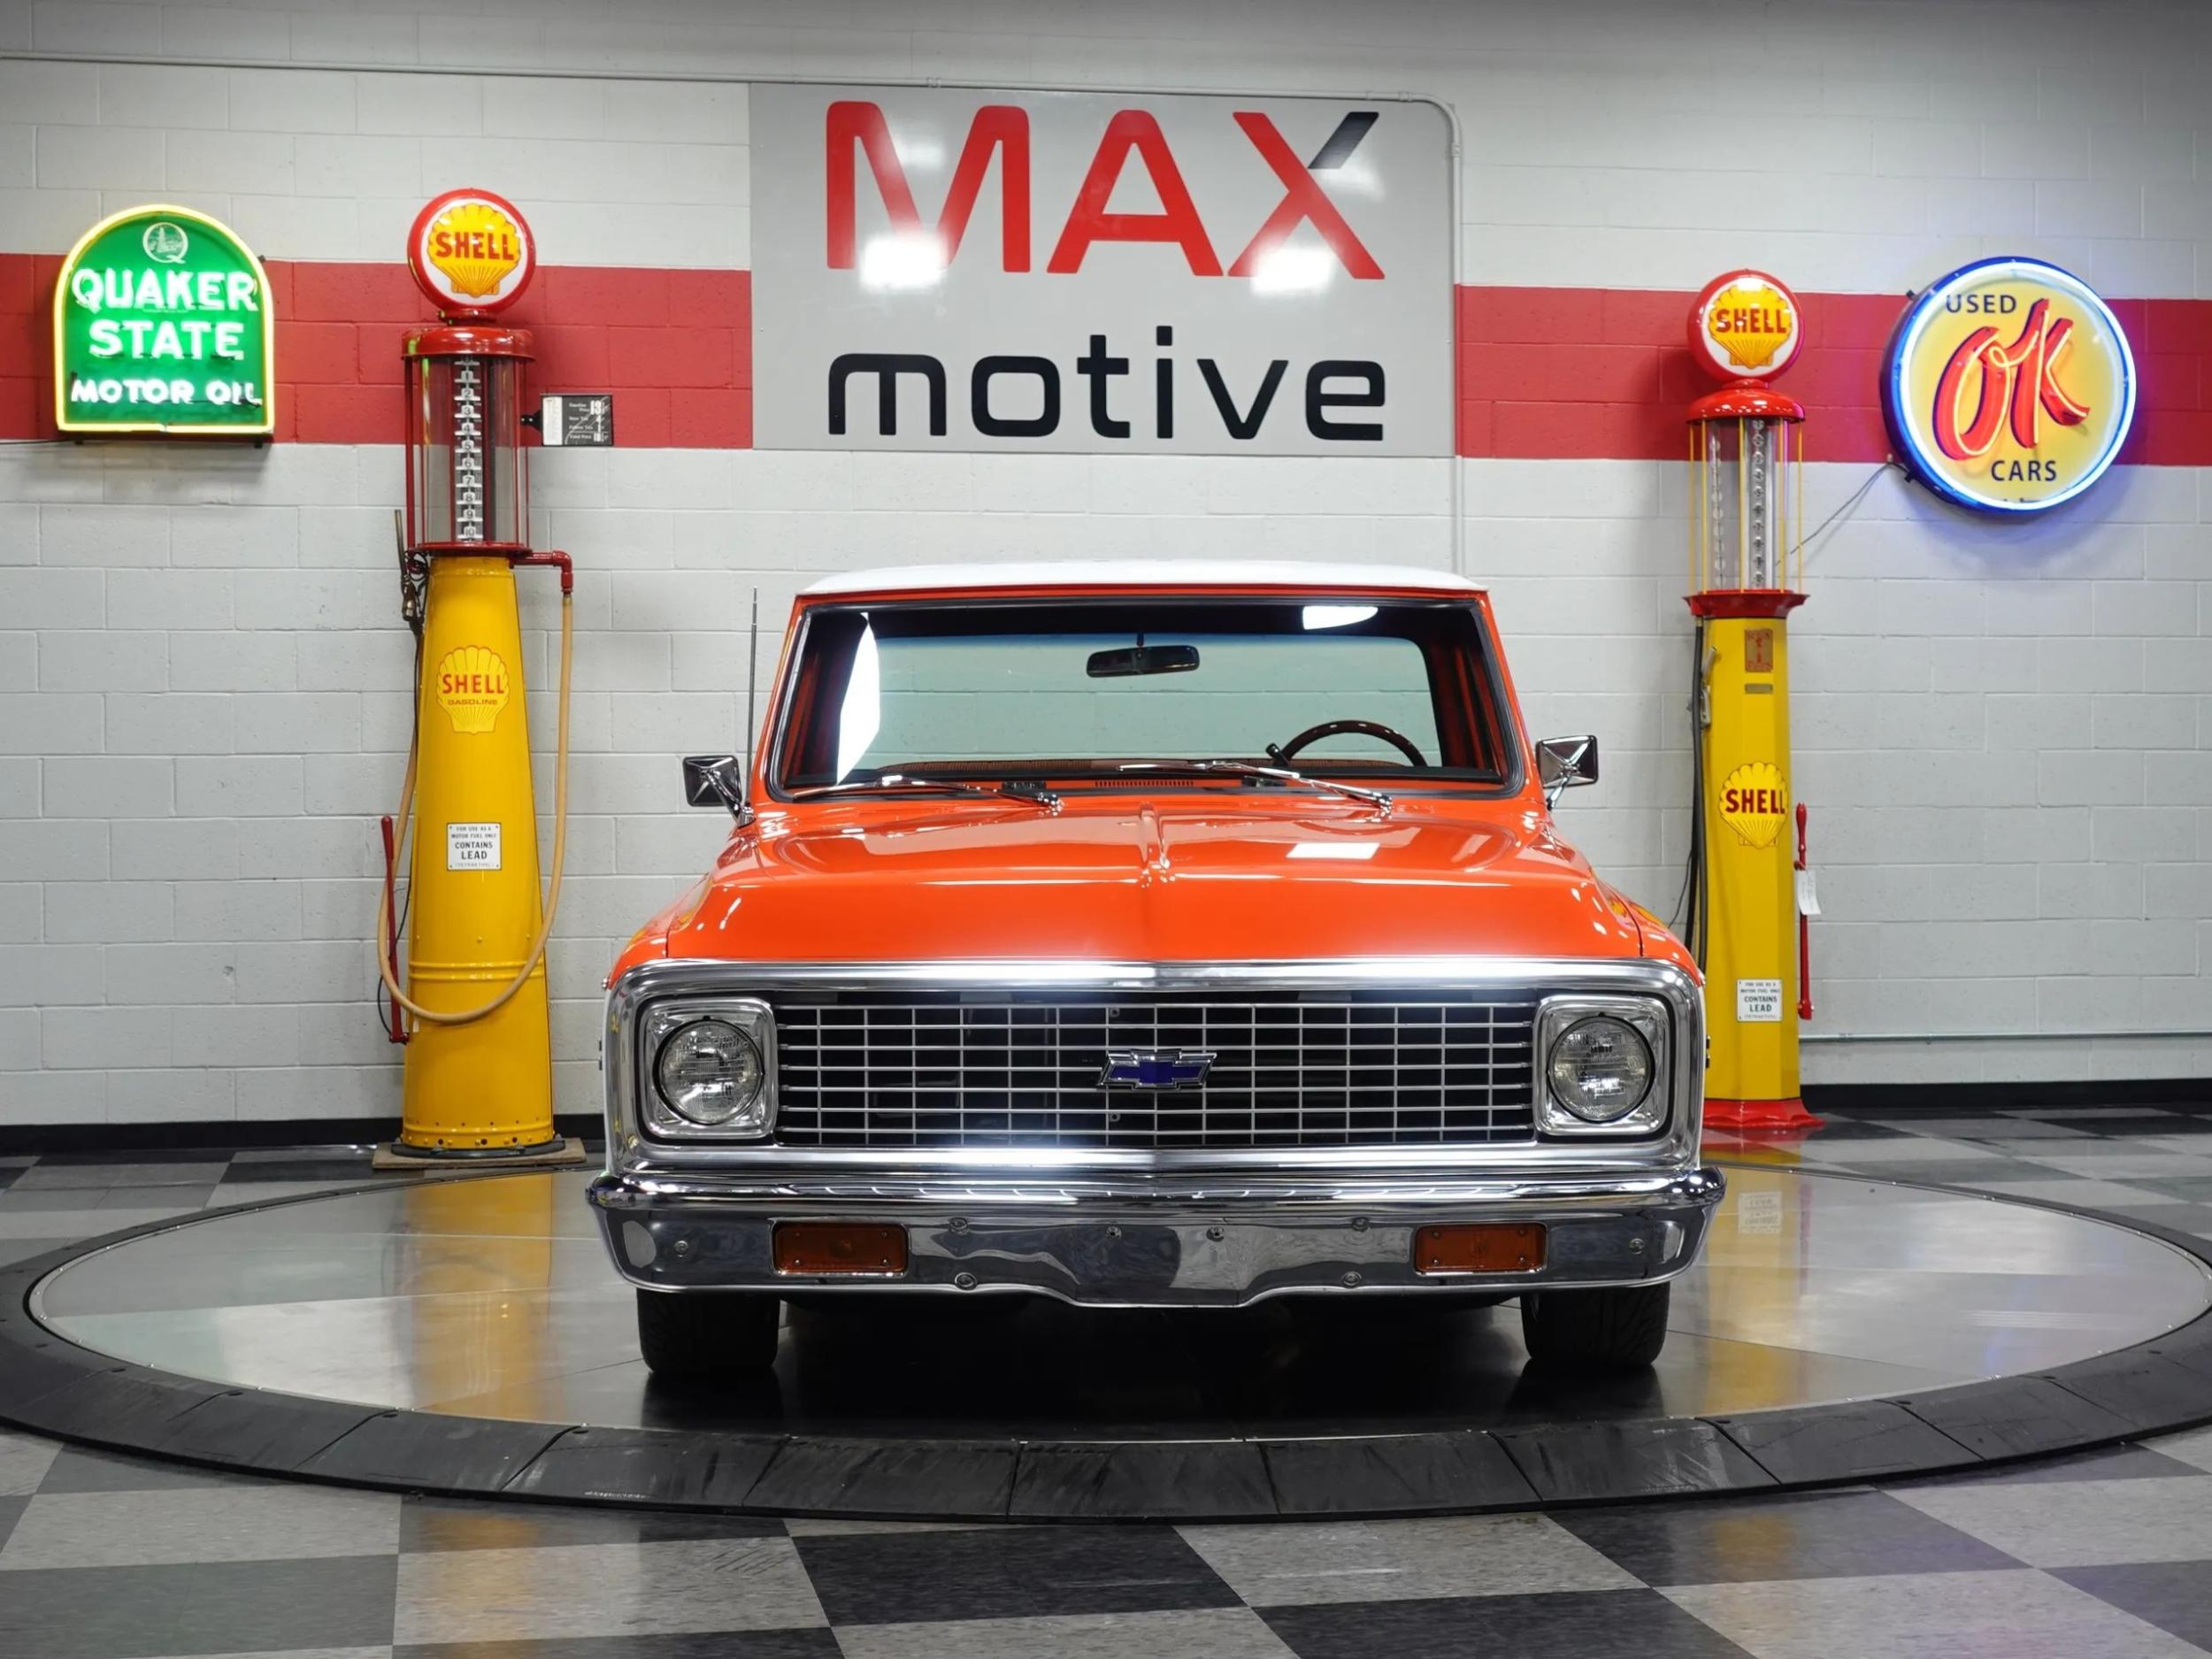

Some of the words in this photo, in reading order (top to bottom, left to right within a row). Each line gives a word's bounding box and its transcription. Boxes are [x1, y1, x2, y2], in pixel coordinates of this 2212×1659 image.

[826, 100, 1386, 280] MAX
[435, 231, 514, 261] SHELL
[71, 267, 258, 313] QUAKER
[1946, 294, 2016, 313] USED
[1716, 308, 1787, 334] SHELL
[88, 319, 244, 360] STATE
[71, 379, 195, 404] MOTOR
[205, 380, 262, 406] OIL
[827, 325, 1386, 441] motive
[1932, 298, 2091, 461] OK
[1991, 460, 2057, 481] CARS
[442, 673, 504, 695] SHELL
[1725, 788, 1786, 815] SHELL
[461, 850, 488, 860] LEAD
[1749, 1003, 1772, 1013] LEAD
